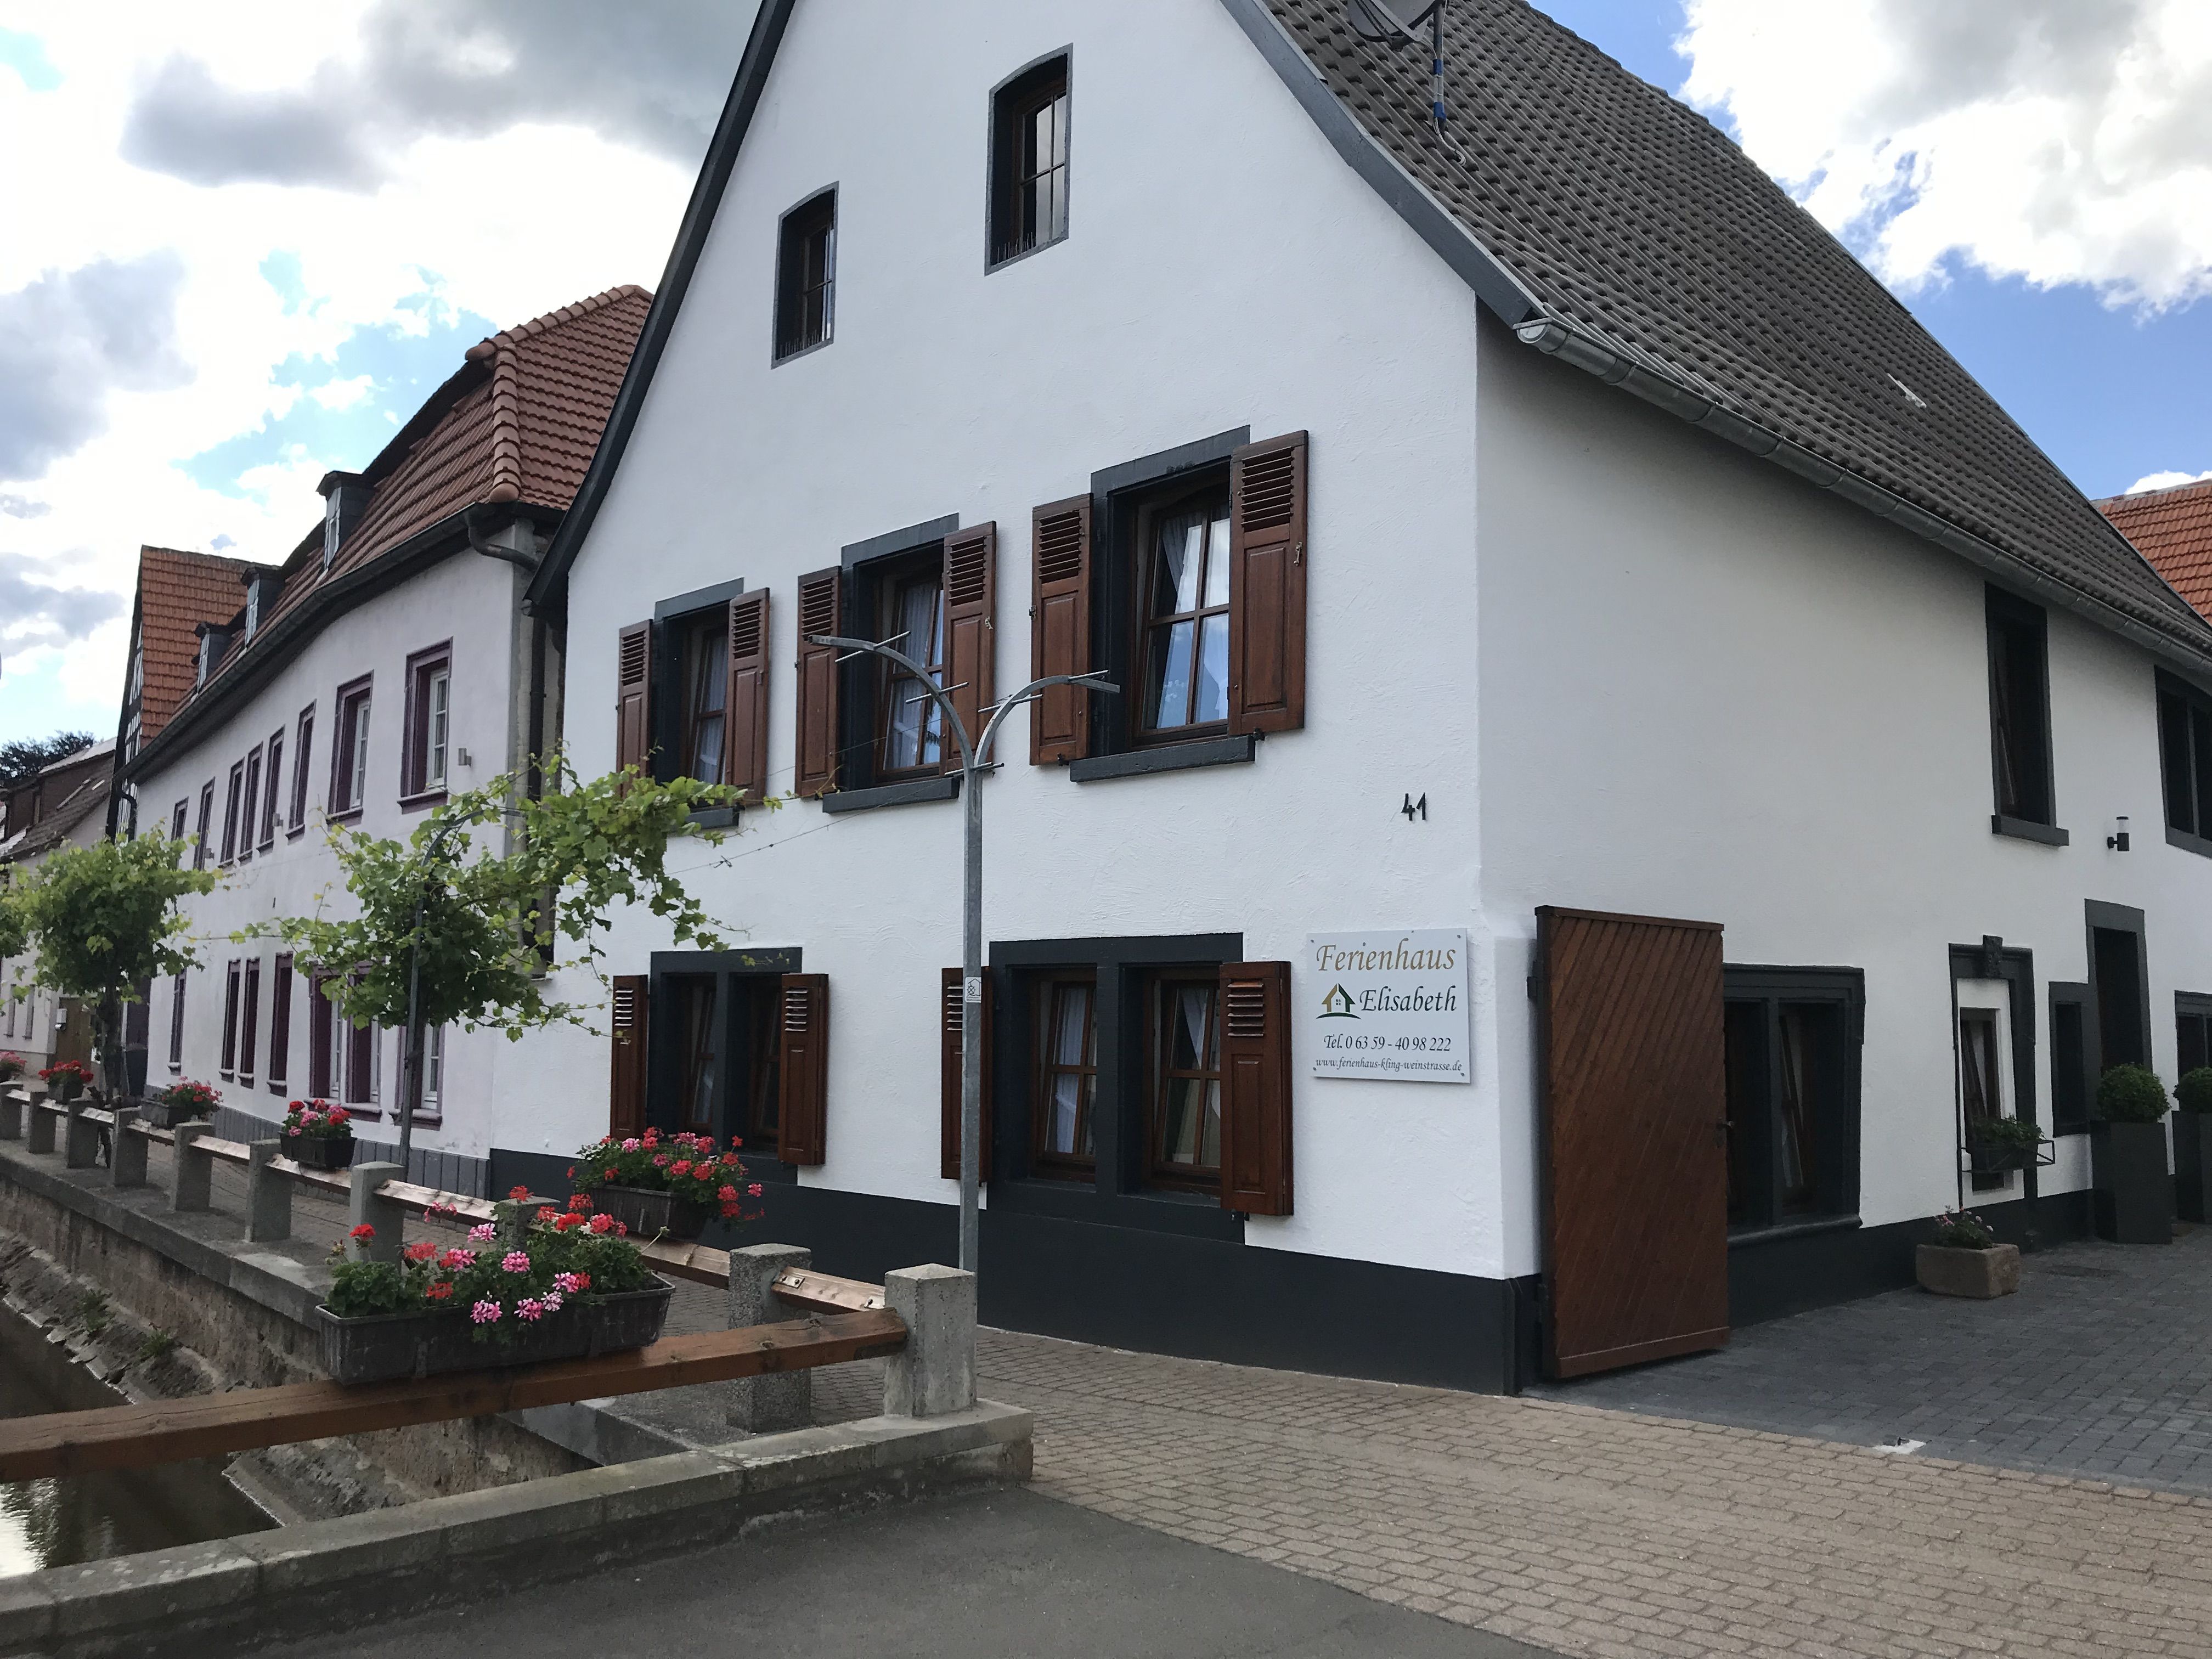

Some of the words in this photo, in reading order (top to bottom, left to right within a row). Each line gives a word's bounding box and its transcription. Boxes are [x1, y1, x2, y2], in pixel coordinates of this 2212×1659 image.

[1401, 792, 1426, 821] 41
[1317, 938, 1456, 971] Ferienhaus
[1359, 985, 1457, 1011] Elisabeth
[1324, 1034, 1343, 1049] Tel.
[1345, 1036, 1353, 1049] 0
[1355, 1036, 1368, 1049] 63
[1371, 1036, 1385, 1049] 59
[1395, 1037, 1409, 1051] 40
[1413, 1037, 1427, 1051] 98
[1429, 1037, 1451, 1051] 222
[1316, 1057, 1462, 1072] www.ferienhaus-kling-weinstrasse.de
